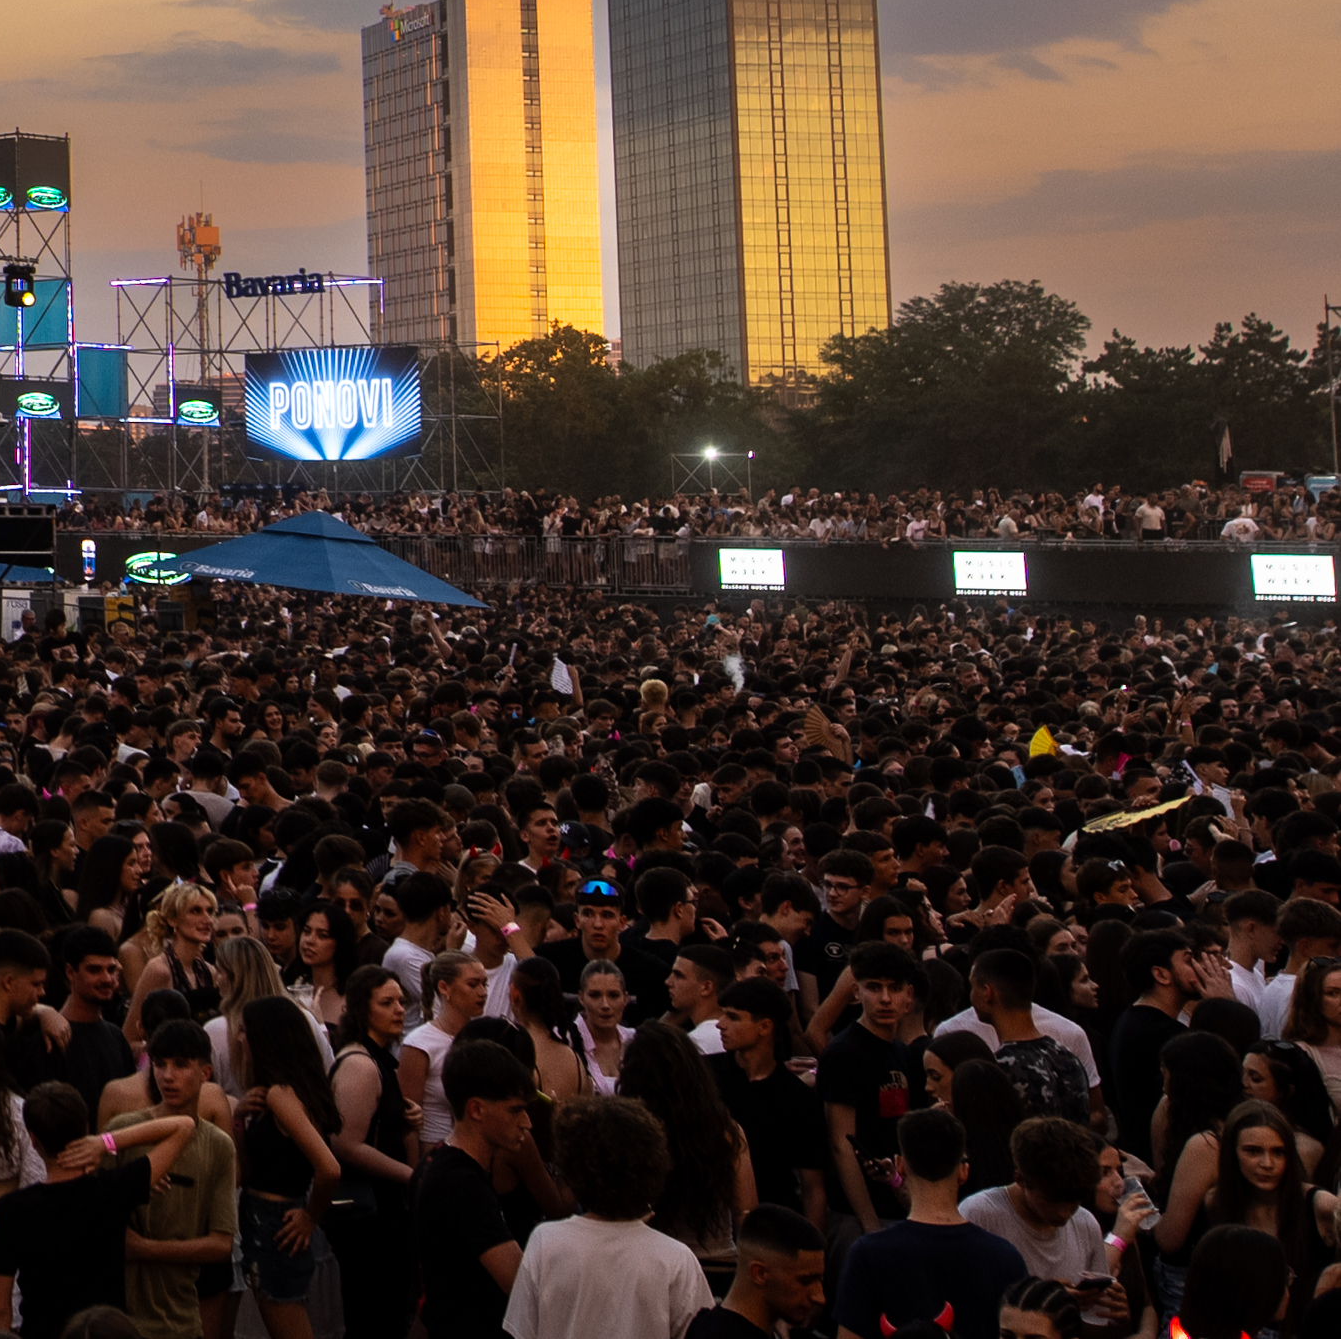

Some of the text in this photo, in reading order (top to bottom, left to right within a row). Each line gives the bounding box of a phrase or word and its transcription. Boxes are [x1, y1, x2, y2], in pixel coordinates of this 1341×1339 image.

[400, 11, 431, 35] Microsoft
[223, 268, 325, 298] Bavaria
[269, 378, 393, 430] PONOVI
[195, 564, 255, 578] Bavaria
[362, 583, 418, 598] Bavaria
